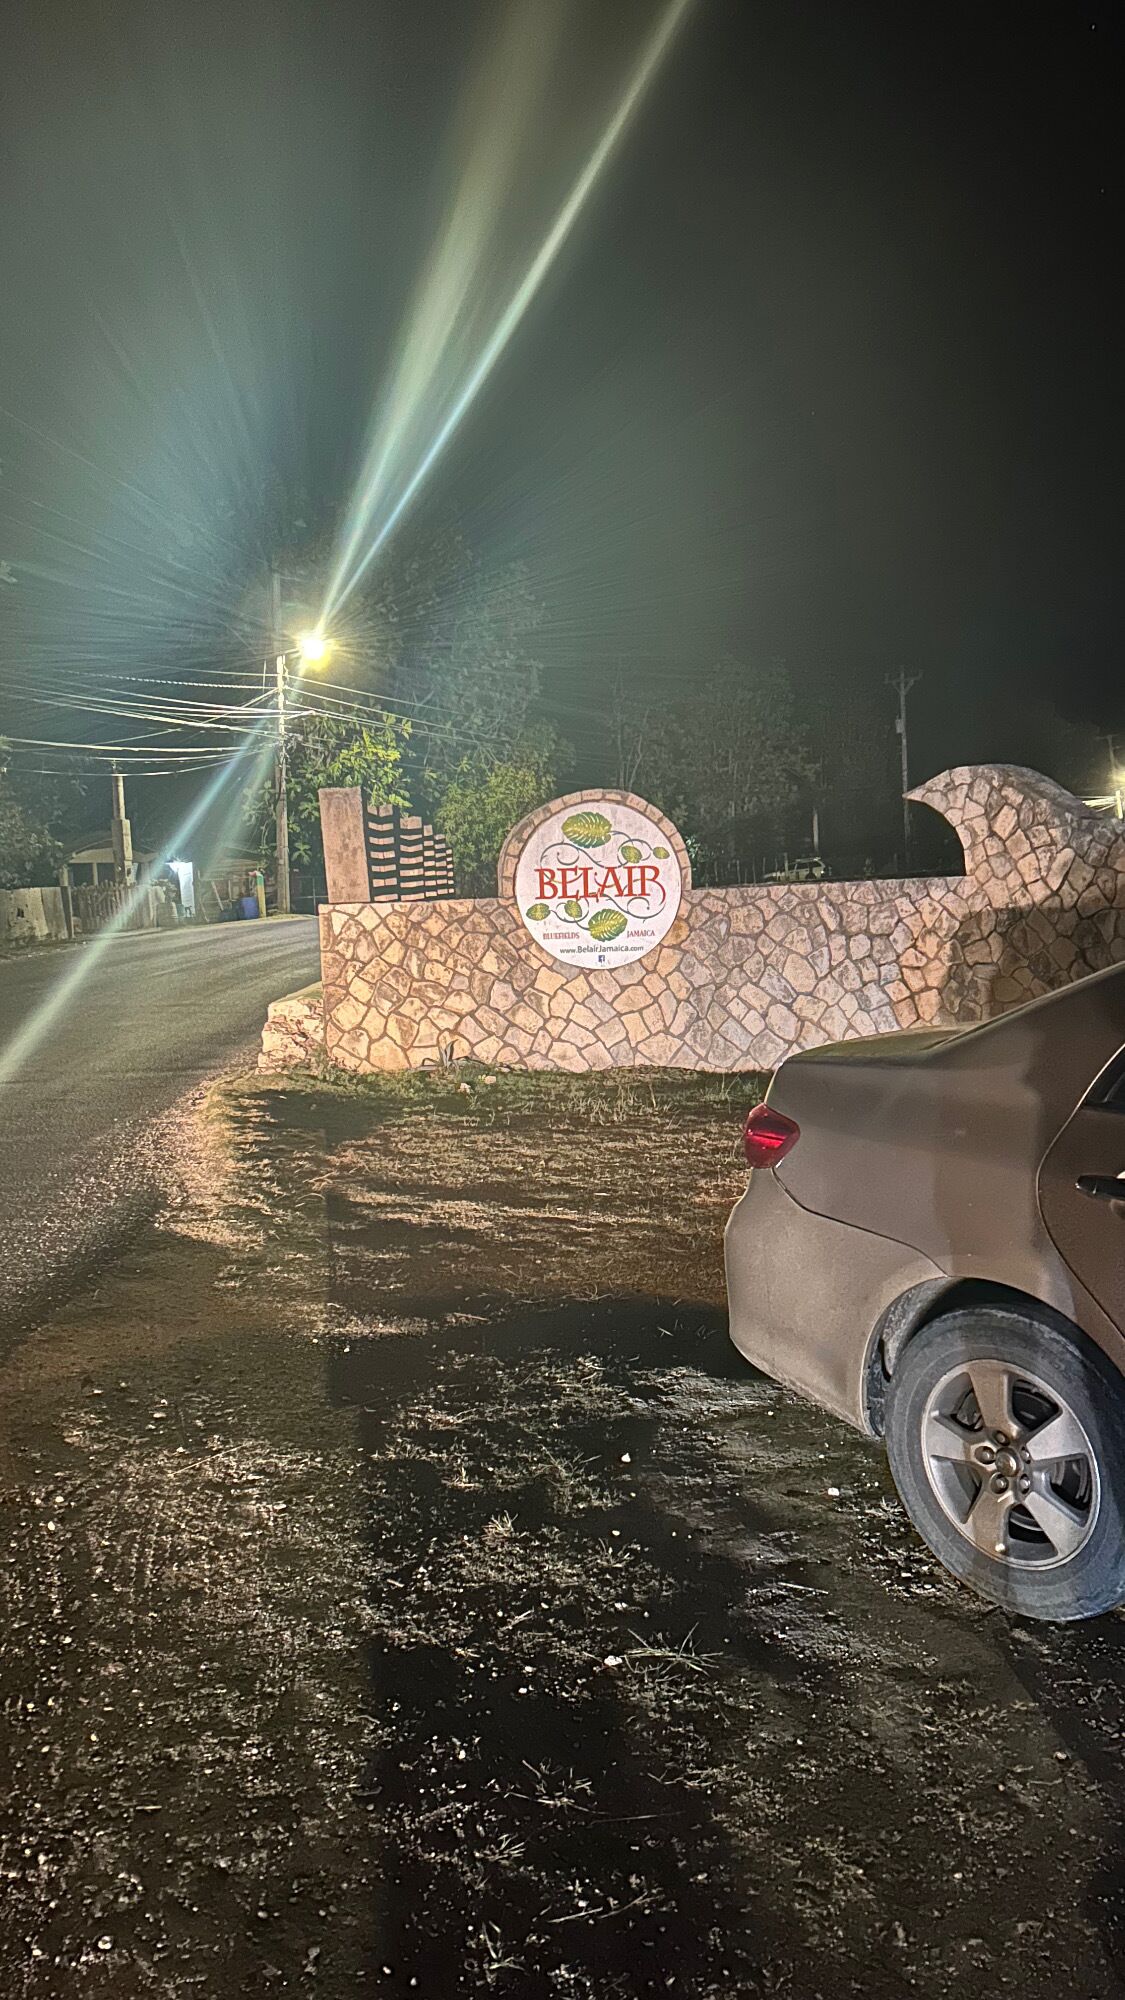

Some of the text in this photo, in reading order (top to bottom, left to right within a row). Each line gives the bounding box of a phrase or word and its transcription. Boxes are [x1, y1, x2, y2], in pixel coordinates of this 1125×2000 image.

[534, 865, 666, 905] BELAIR
[543, 929, 655, 940] BLUEFIELDS JAMAICA
[559, 944, 644, 954] www.BelairJamaica.com
